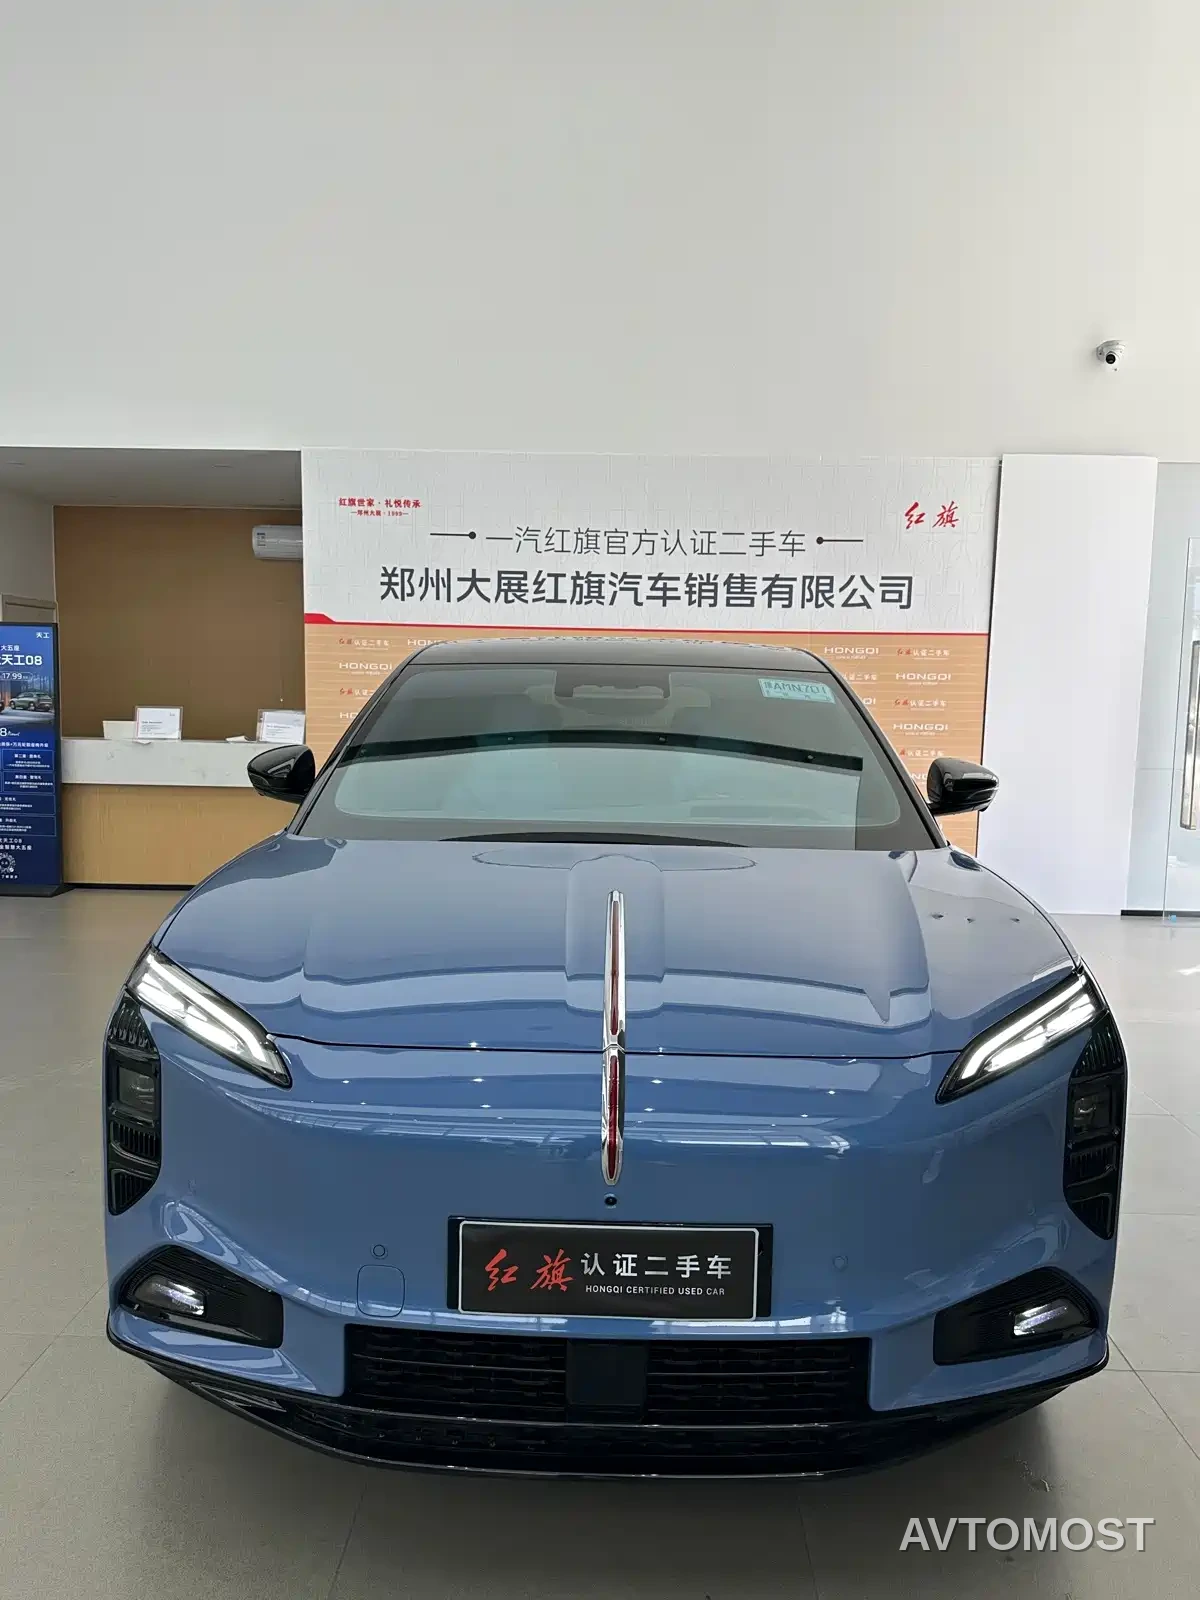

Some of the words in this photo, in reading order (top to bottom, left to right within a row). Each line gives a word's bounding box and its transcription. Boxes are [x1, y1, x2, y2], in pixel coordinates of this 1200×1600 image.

[905, 501, 959, 529] 红旗
[485, 526, 806, 558] 一汽红旗官方认证二手车
[380, 566, 913, 610] 郑州大展红旗汽车销售有限公司
[824, 646, 879, 655] HONGQI
[0, 654, 43, 666] 天工08
[339, 662, 393, 670] HONGQI
[895, 672, 952, 681] HONGQI
[892, 722, 949, 732] HONGQI
[585, 1284, 623, 1294] HONGQI
[626, 1285, 675, 1295] CERTIFIED
[678, 1287, 703, 1296] USED
[706, 1287, 725, 1296] CAR
